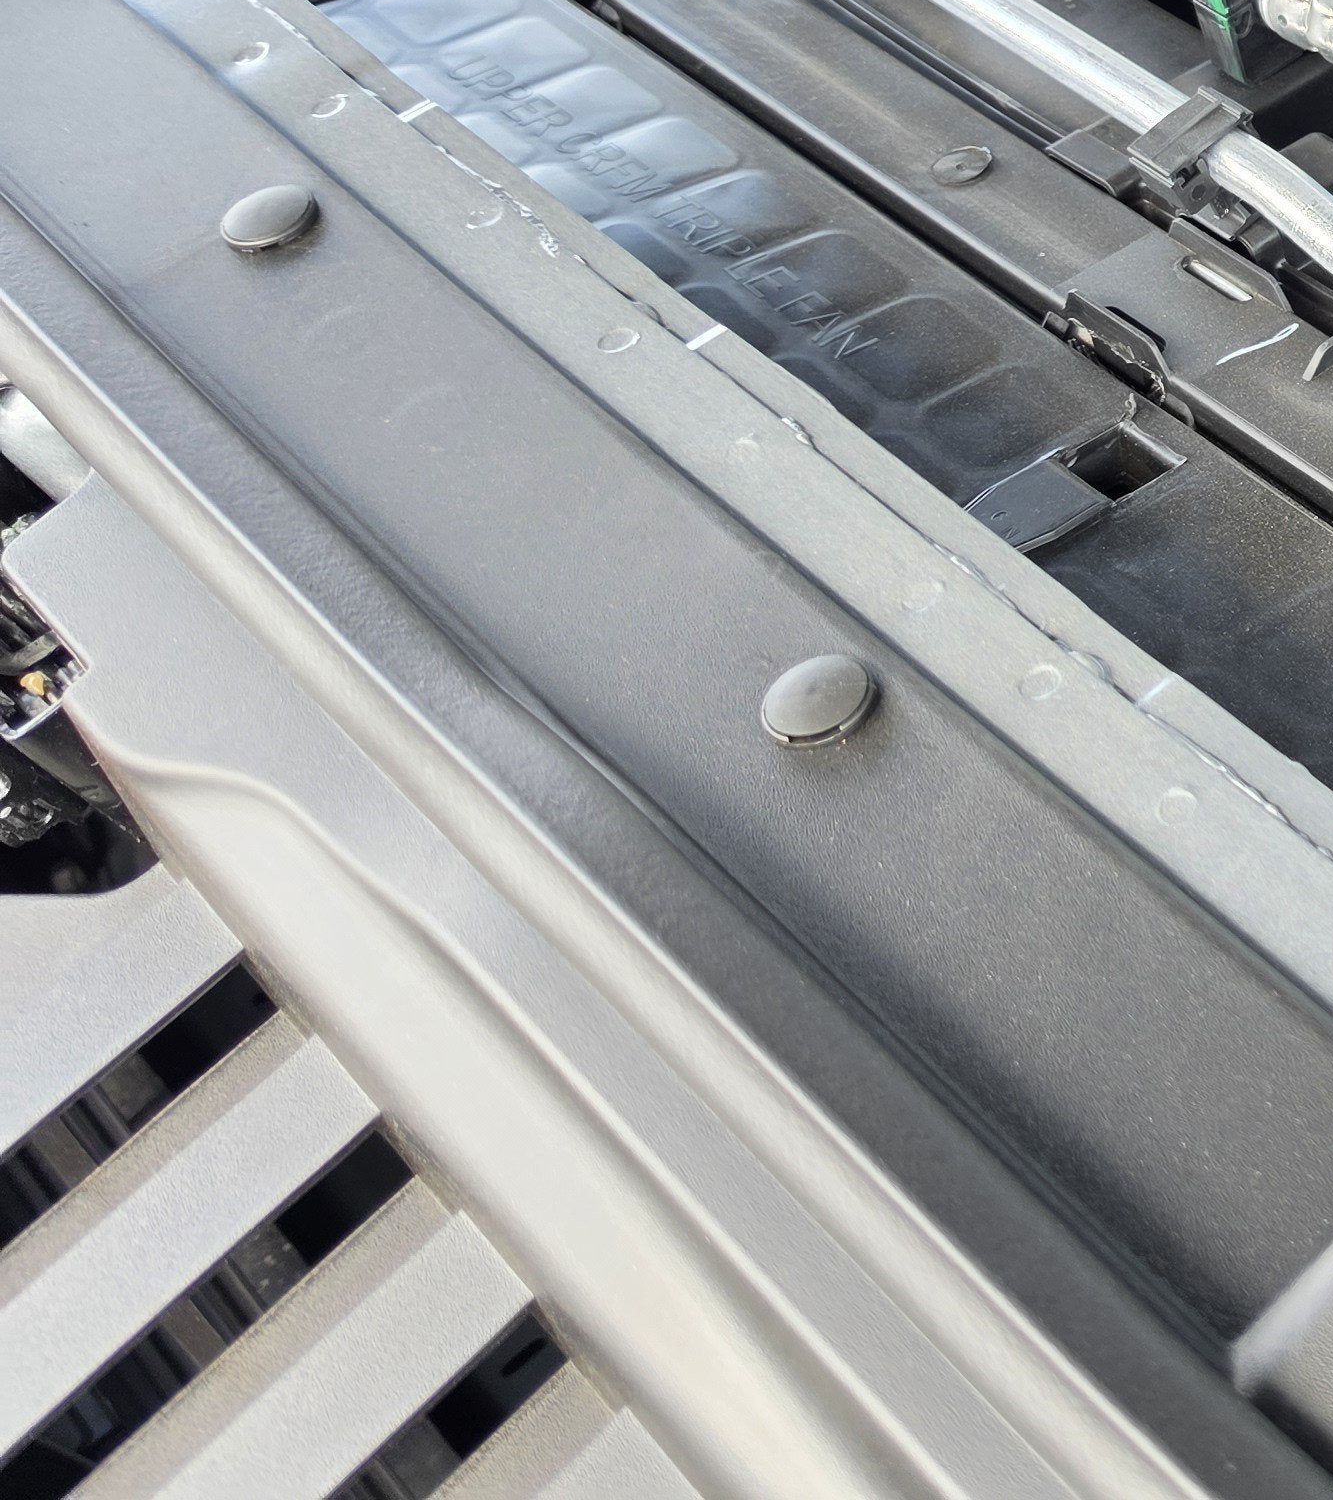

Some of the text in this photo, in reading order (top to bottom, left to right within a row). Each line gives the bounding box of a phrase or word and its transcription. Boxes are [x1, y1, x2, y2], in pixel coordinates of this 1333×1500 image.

[448, 53, 574, 138] UPPER
[655, 193, 801, 299] TRIPLE
[774, 289, 881, 360] FAN
